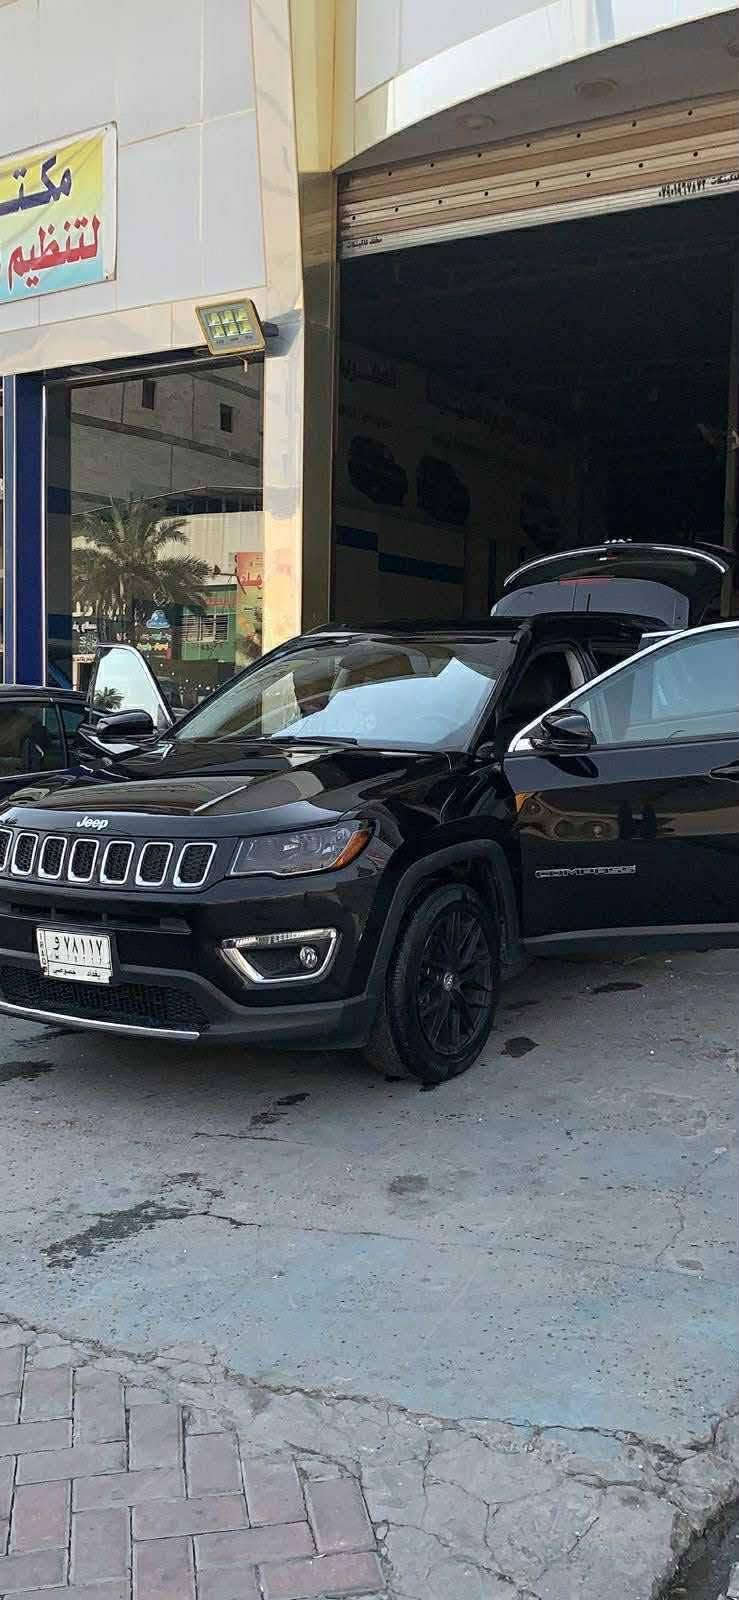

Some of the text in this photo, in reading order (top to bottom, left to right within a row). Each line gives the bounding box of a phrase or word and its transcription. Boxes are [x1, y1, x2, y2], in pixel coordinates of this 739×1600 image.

[8, 214, 101, 292] لتنظيم
[76, 815, 109, 831] Jeep
[535, 865, 637, 879] COMPASS
[63, 936, 103, 957] ٧٨١١٧
